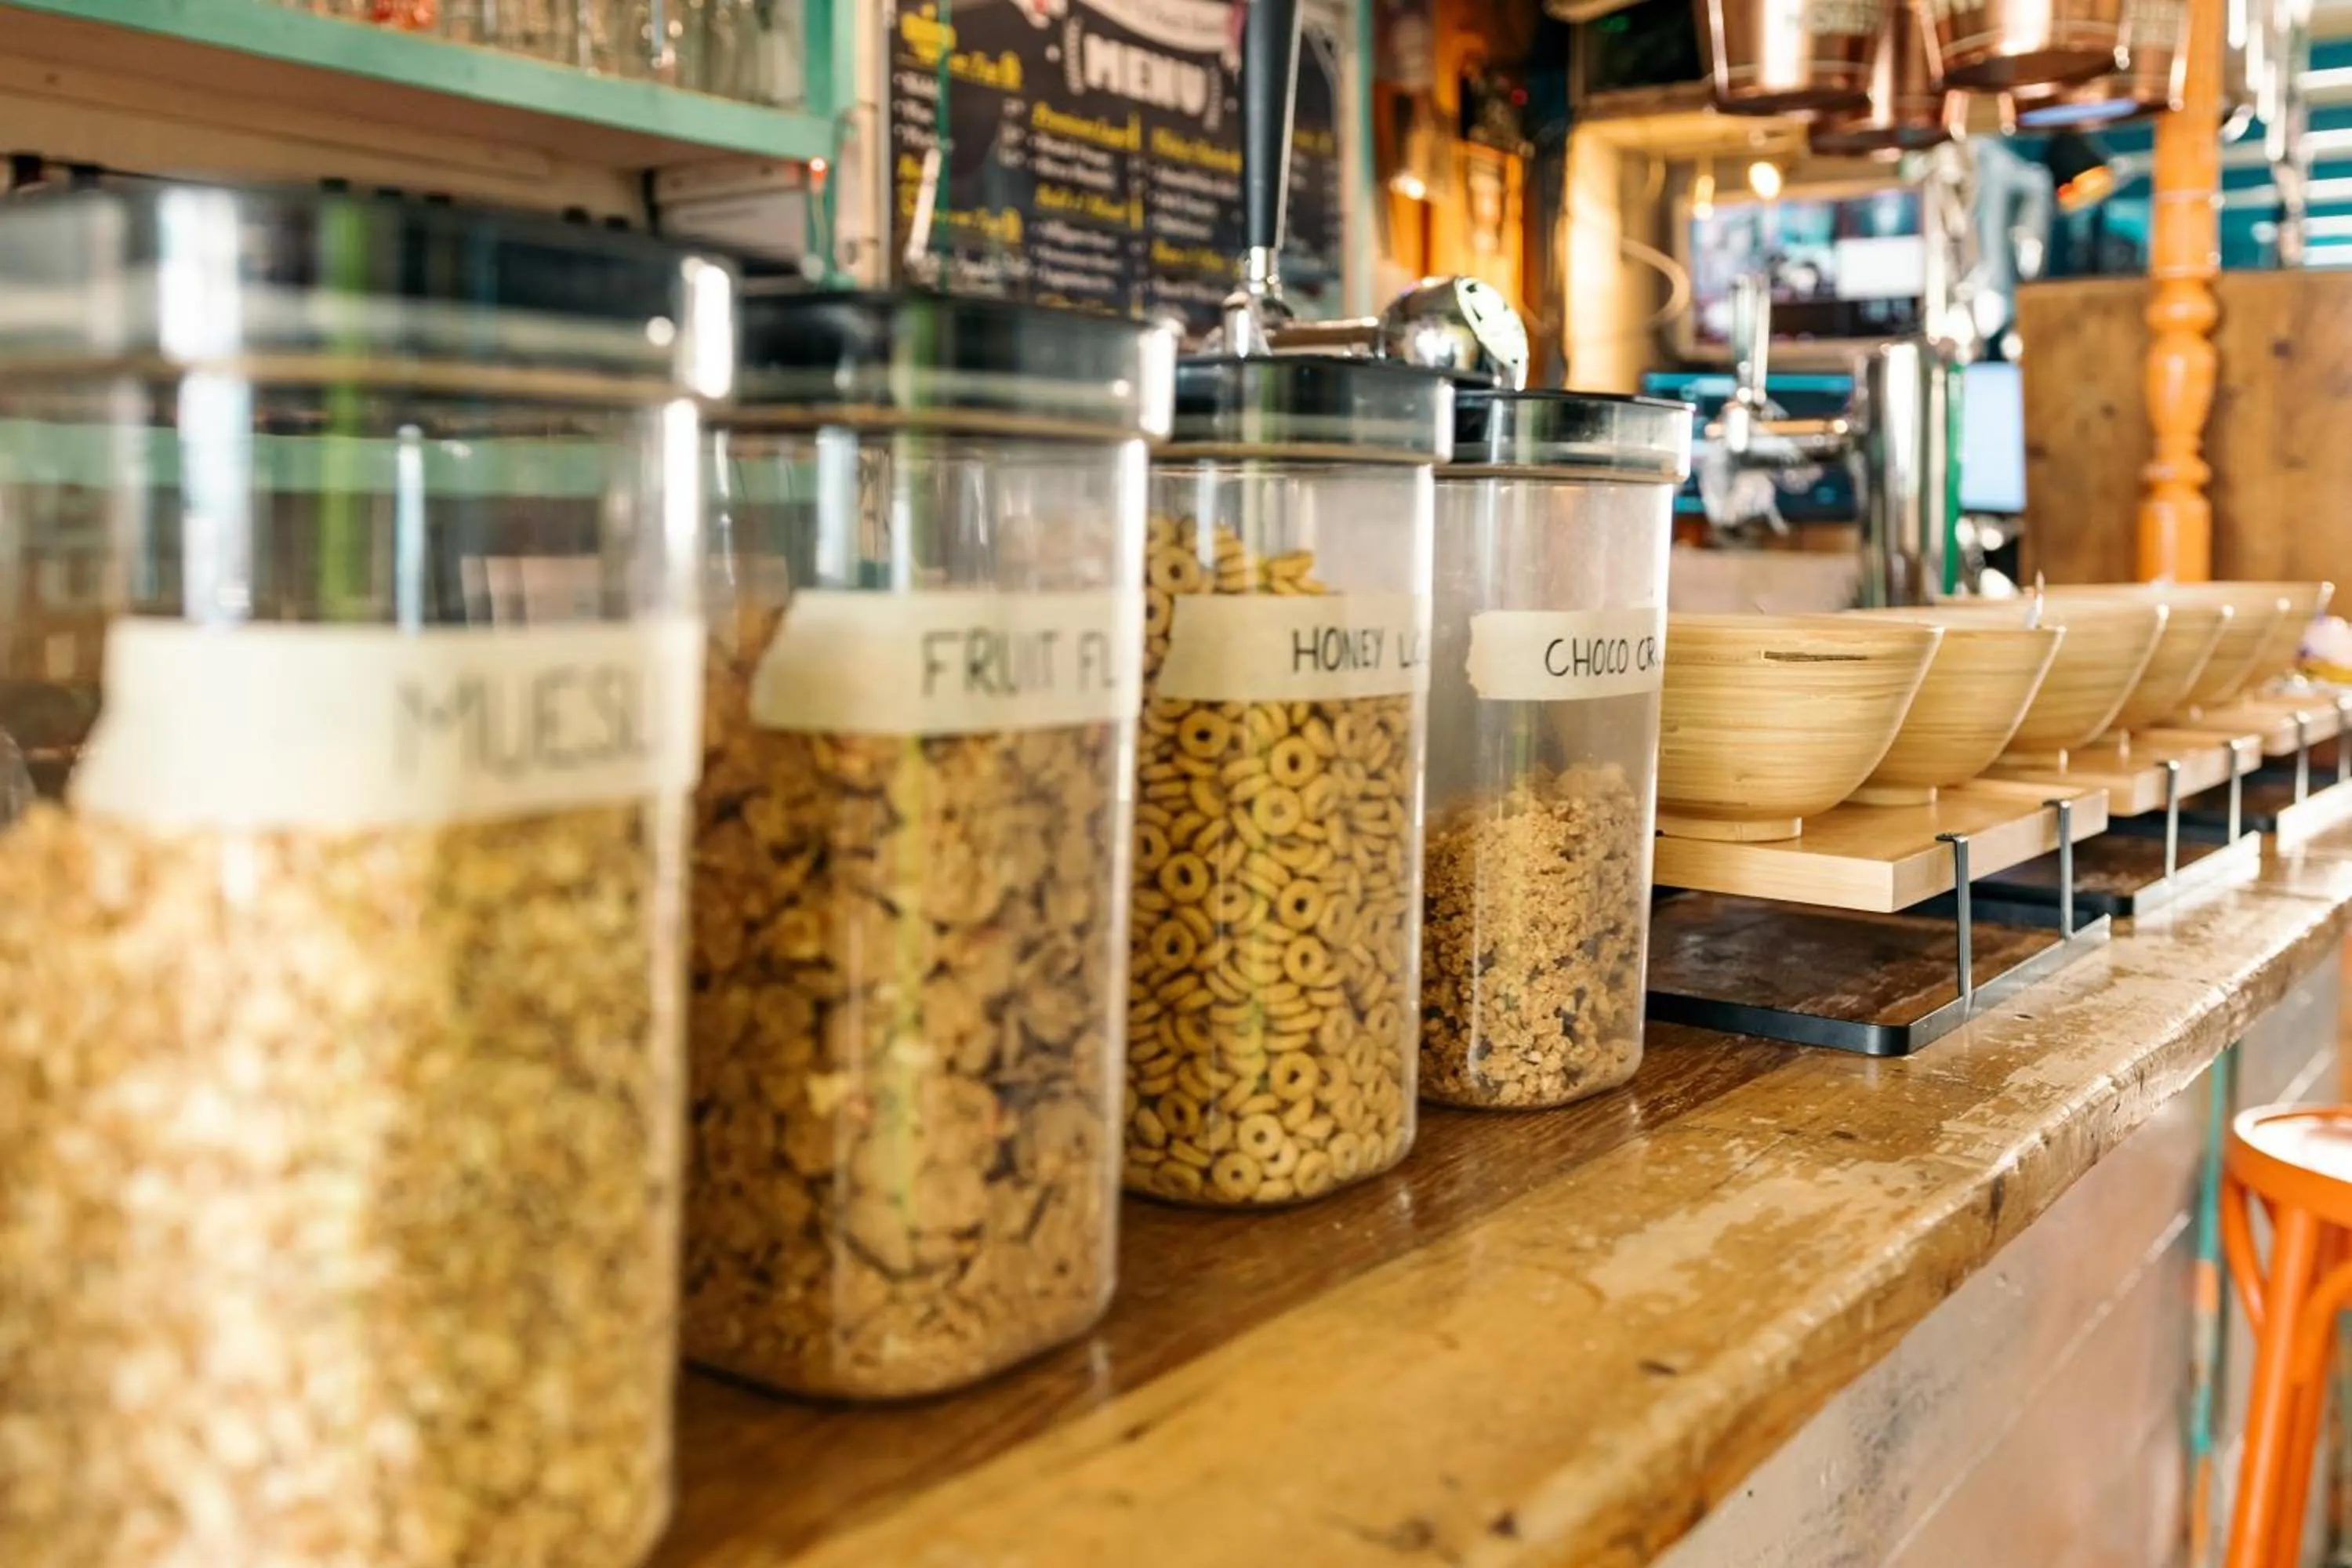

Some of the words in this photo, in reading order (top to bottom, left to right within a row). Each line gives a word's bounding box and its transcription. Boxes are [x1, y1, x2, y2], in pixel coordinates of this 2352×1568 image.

[1083, 31, 1207, 115] MENU
[921, 626, 1058, 698] FRUIT
[1293, 625, 1384, 673] HONEY
[1545, 637, 1628, 677] CHOCO
[1637, 636, 1661, 672] CR
